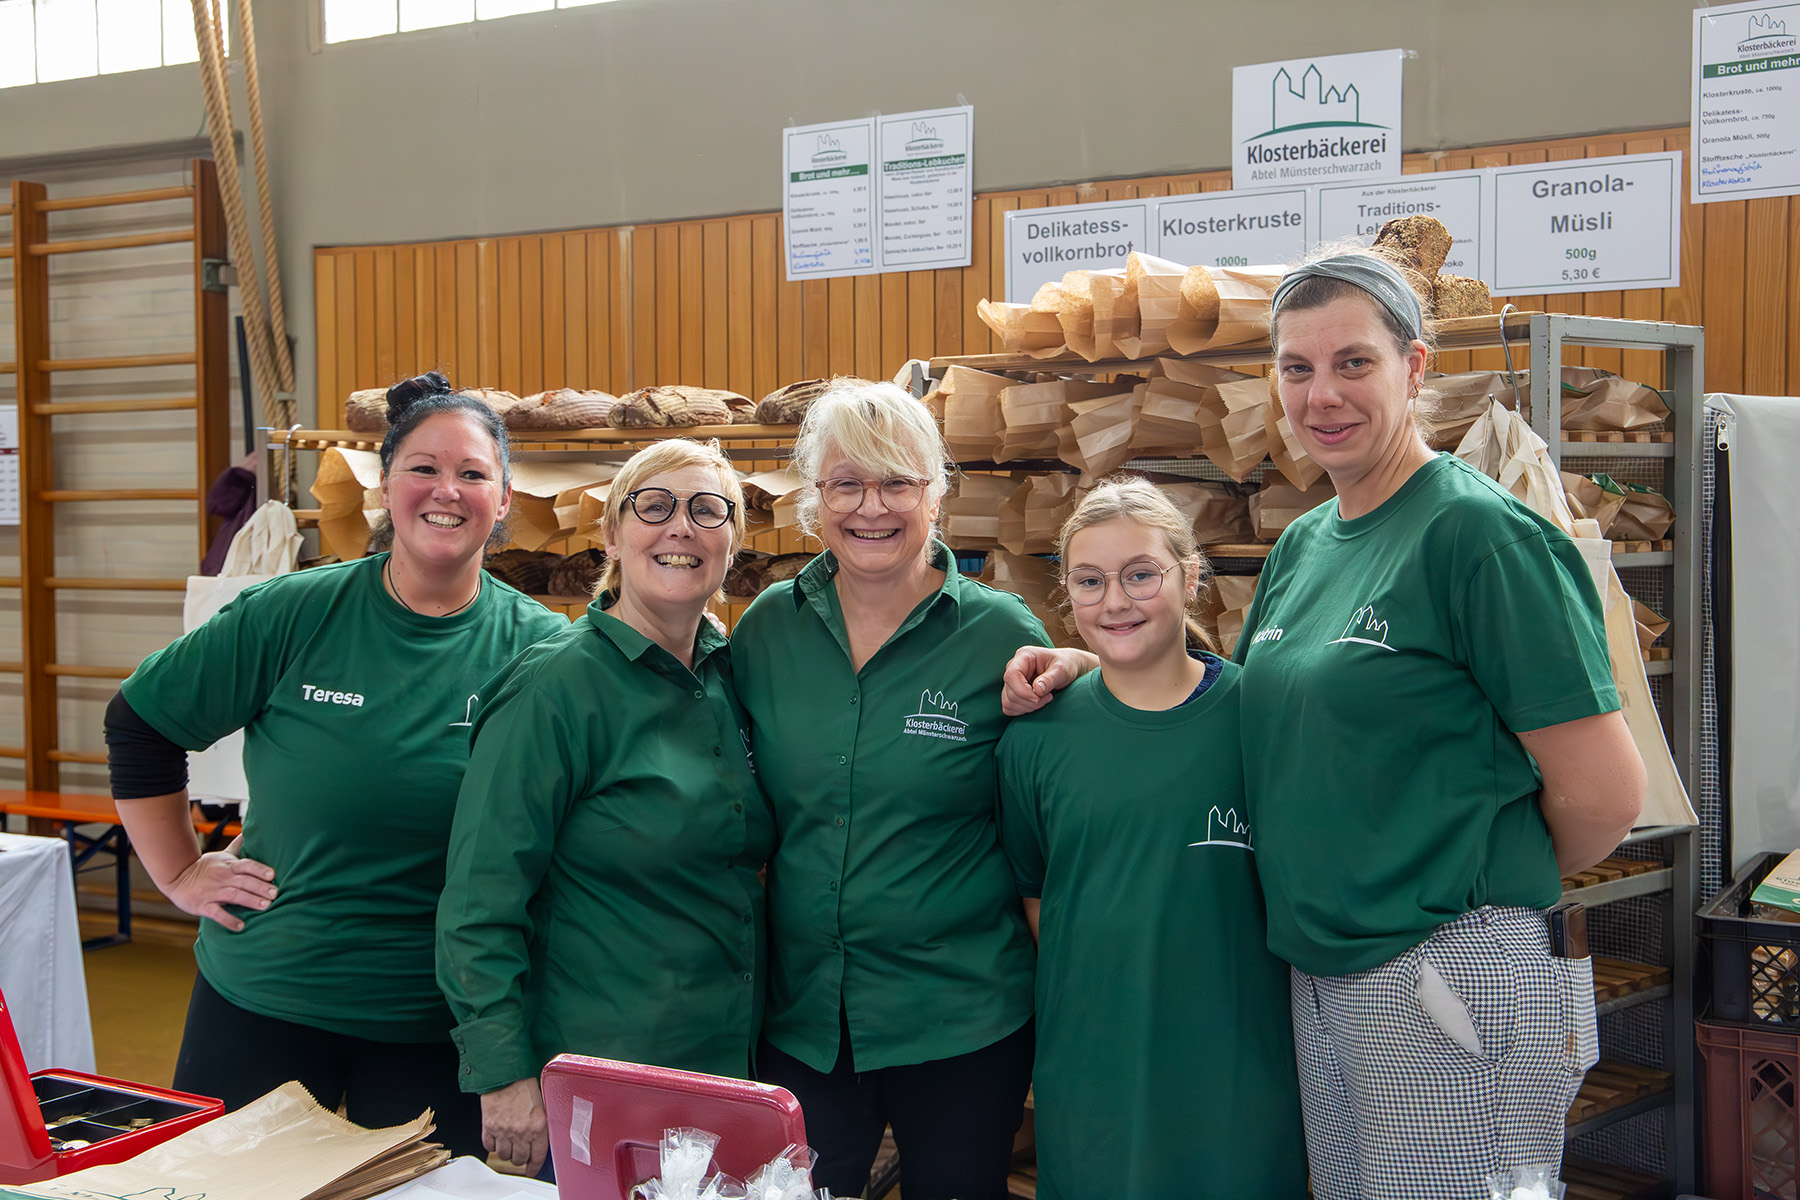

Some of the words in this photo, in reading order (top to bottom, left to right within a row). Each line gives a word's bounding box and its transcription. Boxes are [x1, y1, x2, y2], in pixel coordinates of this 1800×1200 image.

[1737, 38, 1797, 53] Klosterbäckerei
[1717, 64, 1743, 75] Brot
[1745, 60, 1768, 71] und
[1703, 88, 1755, 98] Klosterkruste,
[1702, 109, 1743, 118] Delikatess-
[1702, 115, 1750, 125] Vollkornbrot,
[1702, 136, 1731, 144] Granola
[1247, 133, 1387, 165] Klosterbäckerei
[1702, 154, 1743, 163] Stofftasche
[1251, 168, 1277, 181] Abtei
[1280, 160, 1382, 178] Münsterschwarzach
[1387, 185, 1437, 194] Klosterbäckerei
[1531, 173, 1635, 199] Granola-
[1357, 201, 1442, 217] Traditions-
[1027, 219, 1129, 240] Delikatess-
[1162, 209, 1302, 237] Klosterkruste
[1551, 211, 1613, 234] Müsli
[1022, 240, 1134, 264] vollkornbrot
[1565, 247, 1597, 261] 500g
[1215, 255, 1248, 267] 1000g
[1561, 268, 1589, 282] 5,30
[1592, 267, 1601, 279] €
[302, 684, 365, 707] Teresa
[905, 718, 966, 735] Klosterbäckerei
